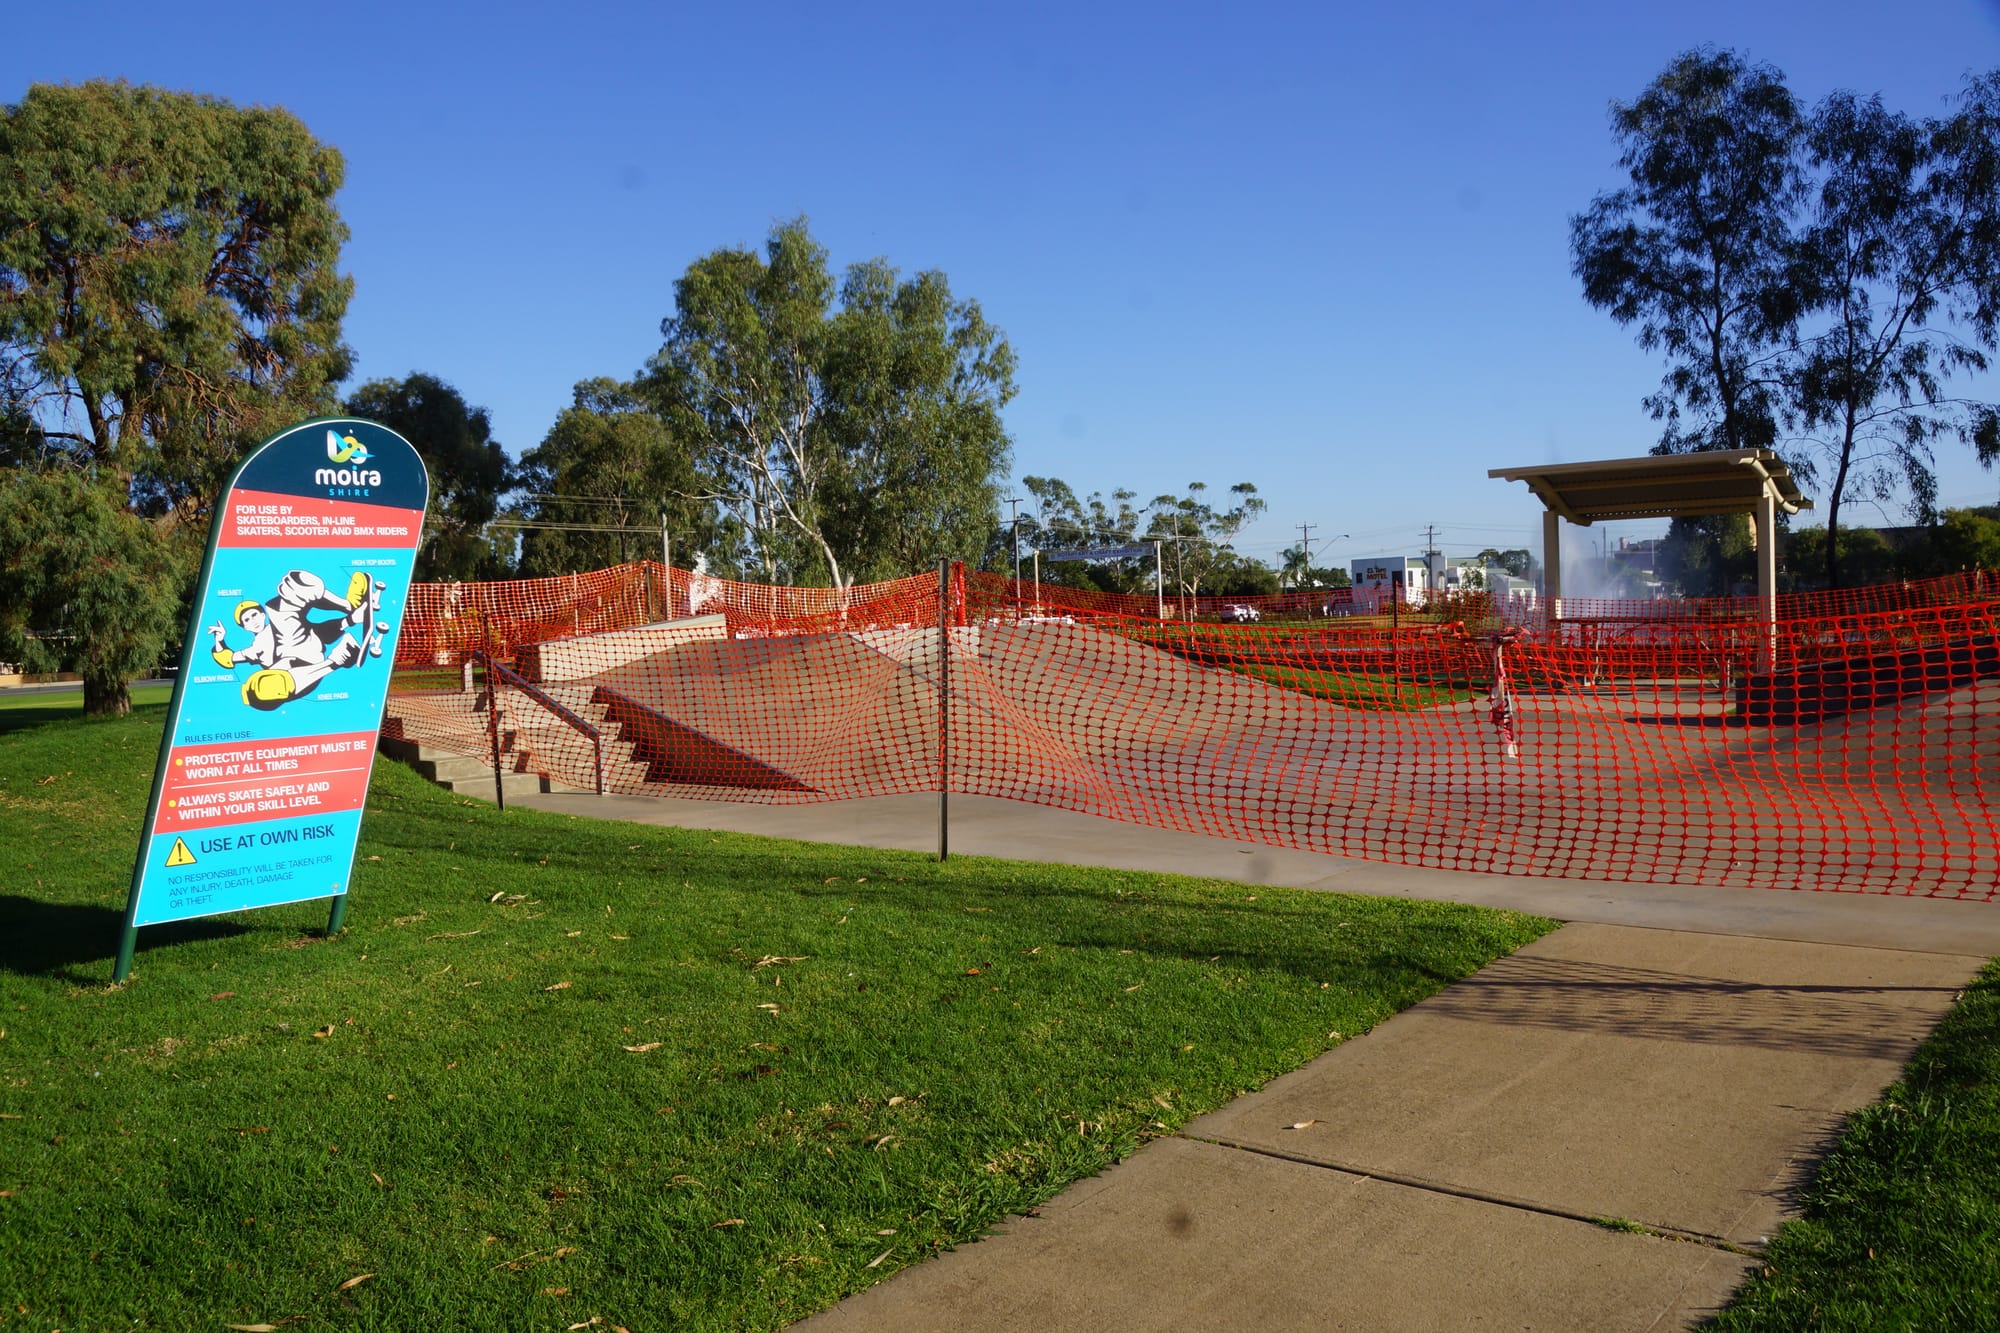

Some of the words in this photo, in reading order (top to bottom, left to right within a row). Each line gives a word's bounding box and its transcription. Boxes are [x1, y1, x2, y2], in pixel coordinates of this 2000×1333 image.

[315, 466, 382, 486] moira
[236, 505, 256, 514] FOR
[258, 506, 278, 514] USE
[280, 506, 292, 514] BY
[236, 516, 320, 526] SKATEBOARDERS,
[322, 516, 355, 526] IN-LINE
[237, 526, 282, 536] SKATERS,
[285, 526, 329, 535] SCOOTER
[331, 527, 352, 535] AND
[354, 527, 374, 535] BMX
[377, 527, 408, 535] RIDERS
[185, 735, 212, 743] RULES
[215, 733, 232, 741] FOR
[185, 751, 253, 766] PROTECTIVE
[256, 745, 319, 760] EQUIPMENT
[321, 742, 351, 754] MUST
[354, 740, 366, 750] BE
[186, 767, 222, 779] WORN
[226, 765, 240, 776] AT
[242, 763, 263, 774] ALL
[265, 759, 298, 772] TIMES
[178, 793, 226, 807] ALWAYS
[228, 789, 263, 802] SKATE
[265, 785, 304, 798] SAFELY
[307, 782, 330, 792] AND
[178, 807, 221, 820] WITHIN
[223, 803, 255, 815] YOUR
[257, 799, 287, 811] SKILL
[289, 795, 321, 808] LEVEL
[201, 837, 232, 854] USE
[237, 834, 256, 849] AT
[260, 829, 298, 845] OWN
[303, 824, 335, 840] RISK
[168, 876, 182, 885] NO
[184, 866, 252, 884] RESPONSIBILITY
[254, 864, 273, 873] WILL
[276, 862, 286, 870] BE
[288, 858, 315, 869] TAKEN
[316, 855, 332, 865] FOR
[169, 888, 188, 898] ANY
[191, 883, 223, 894] INJURY,
[225, 879, 254, 889] DEATH,
[257, 872, 294, 884] DAMAGE
[170, 900, 183, 909] OR
